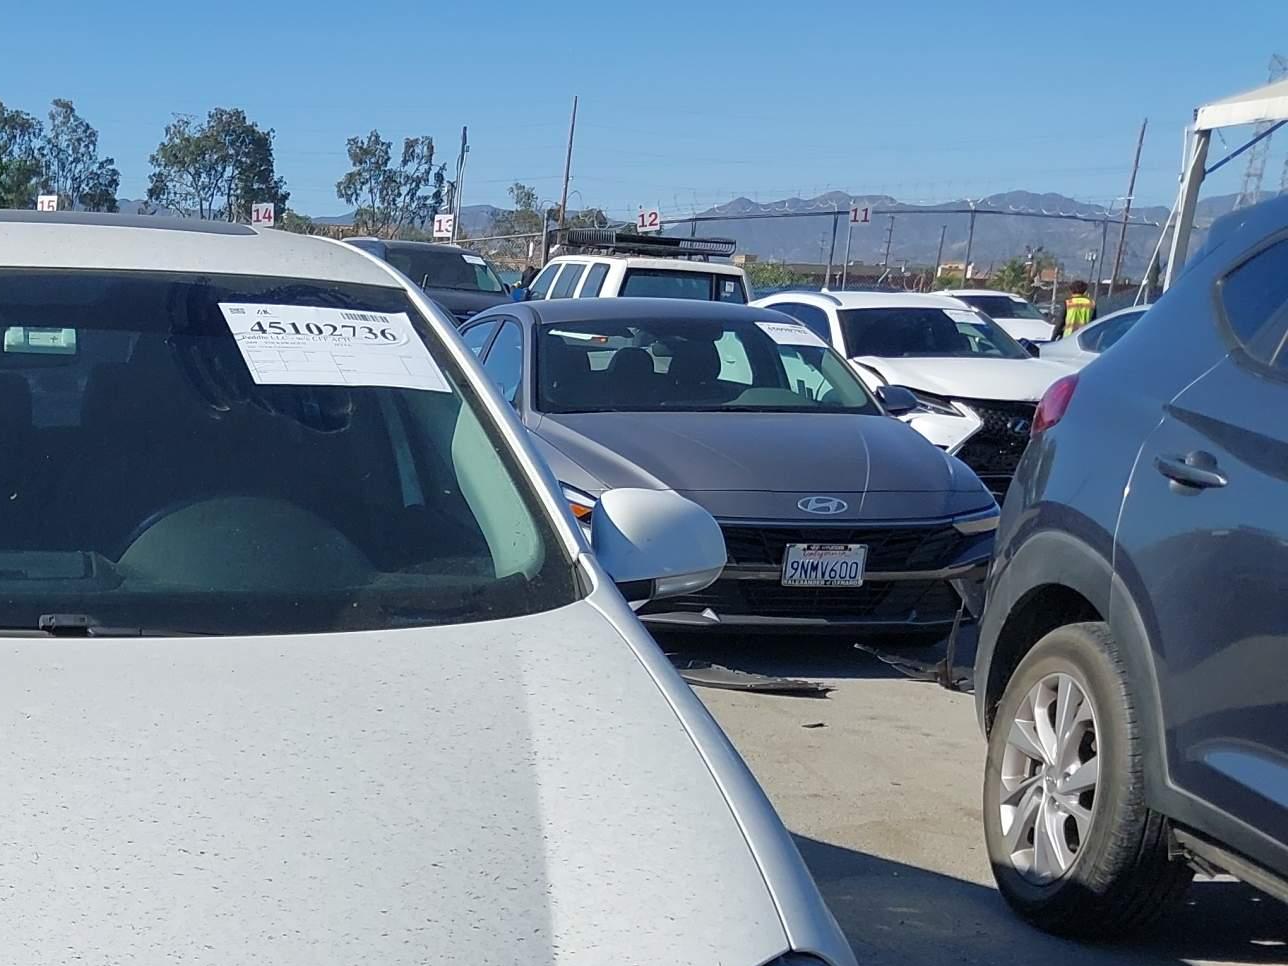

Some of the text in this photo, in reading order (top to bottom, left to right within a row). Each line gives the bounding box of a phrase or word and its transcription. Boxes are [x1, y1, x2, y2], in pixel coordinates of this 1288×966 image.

[39, 199, 55, 212] 15
[253, 208, 272, 223] 14
[639, 212, 658, 228] 12
[850, 207, 870, 223] 11
[250, 321, 397, 342] 45102736
[790, 560, 859, 580] 9NMV600
